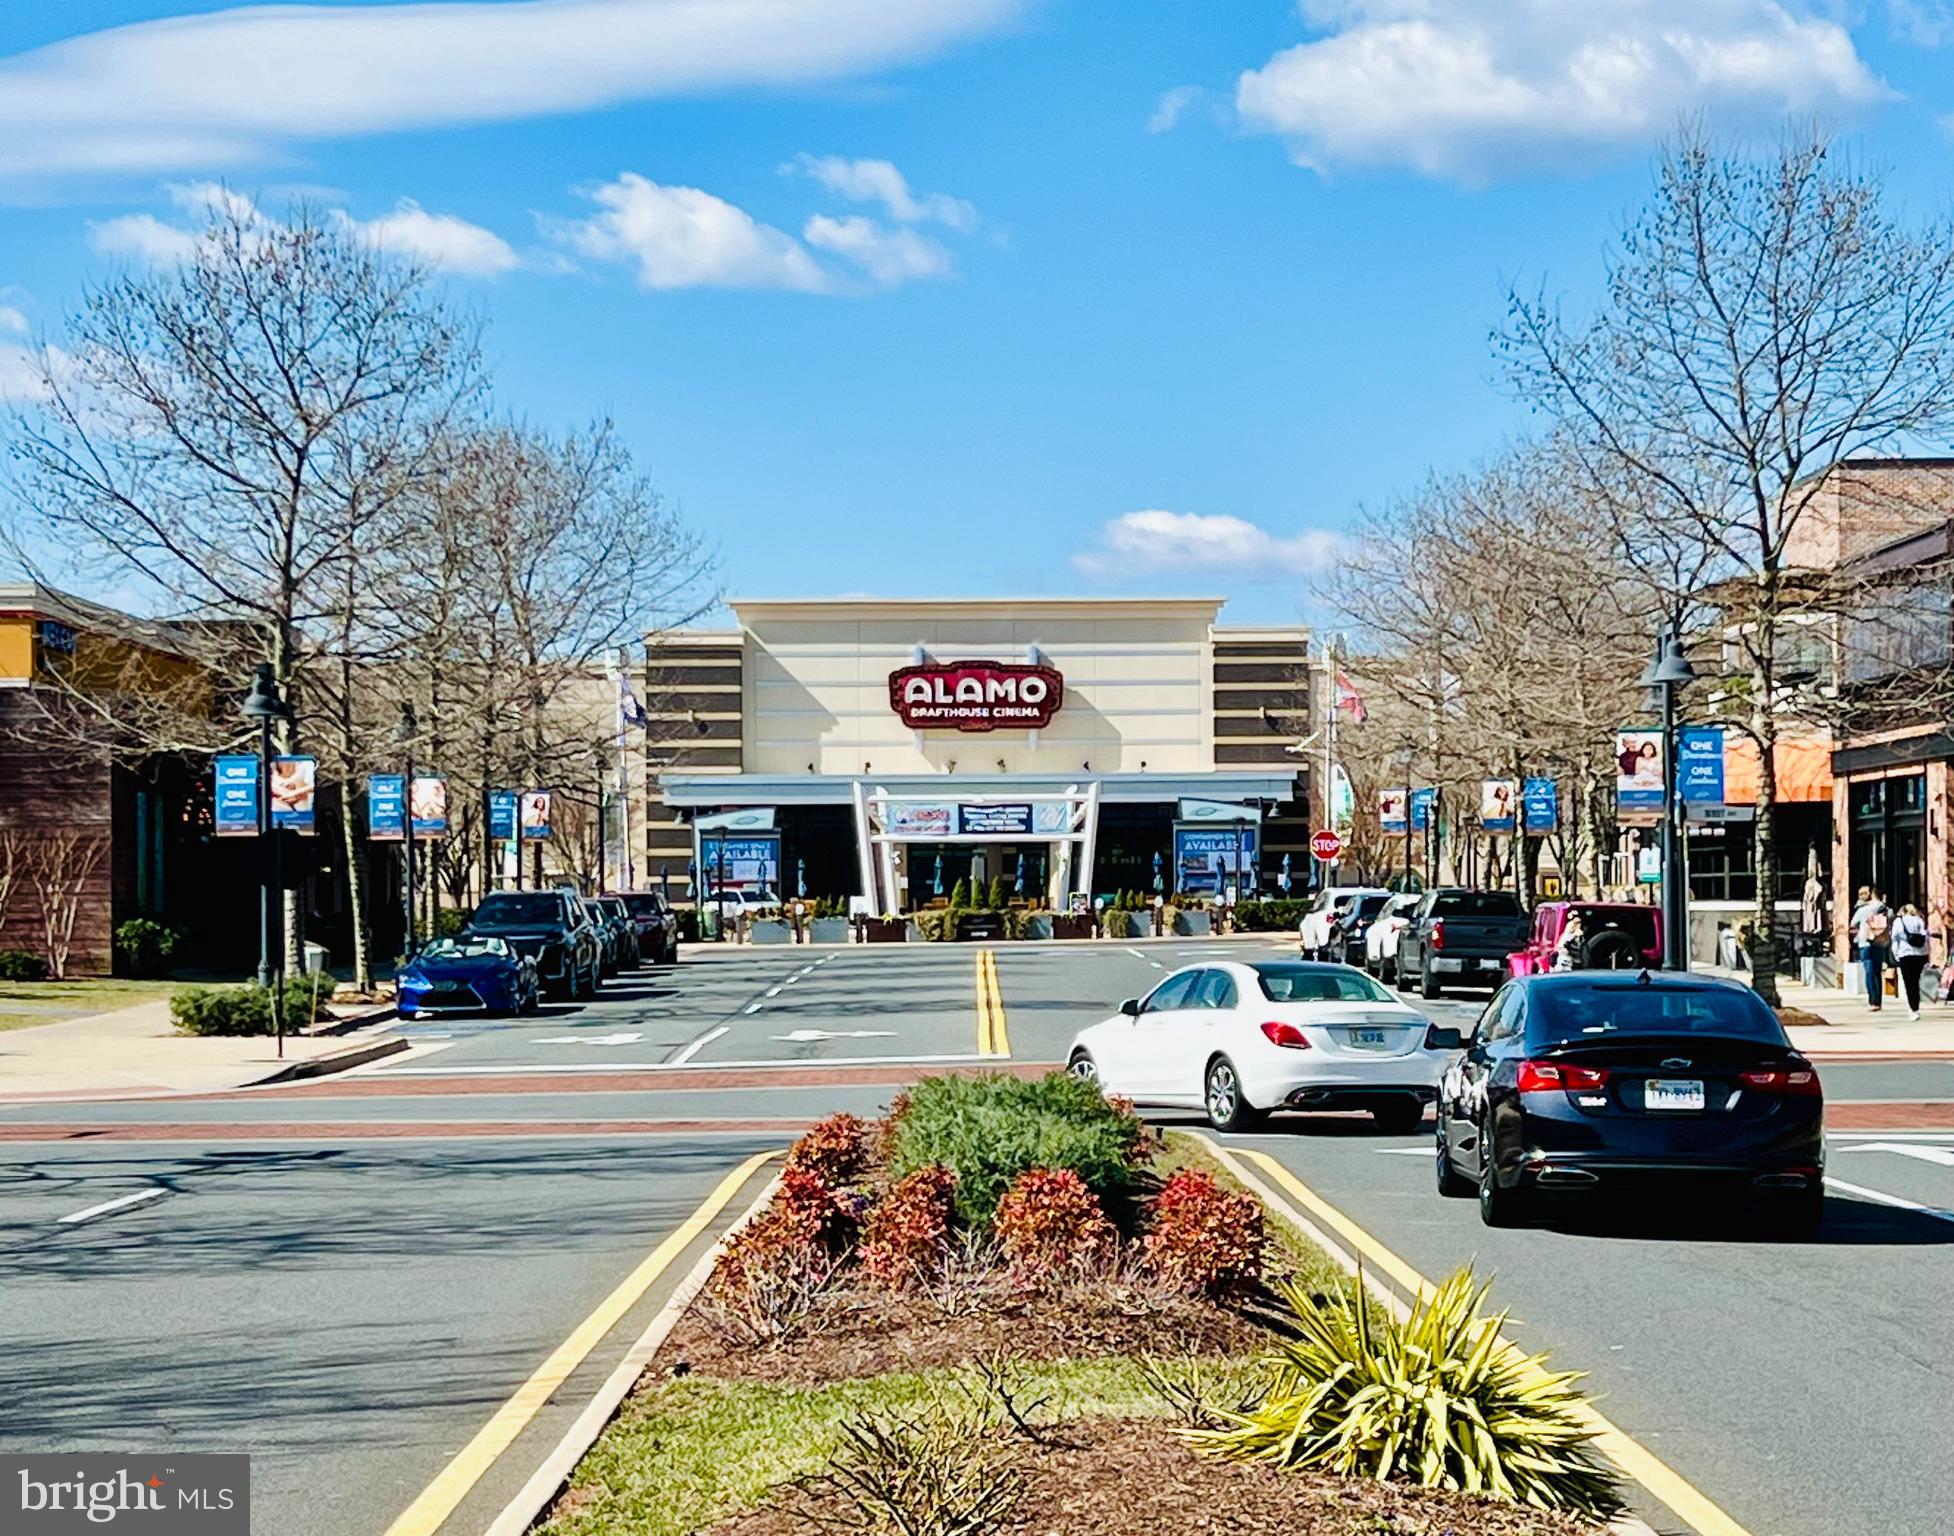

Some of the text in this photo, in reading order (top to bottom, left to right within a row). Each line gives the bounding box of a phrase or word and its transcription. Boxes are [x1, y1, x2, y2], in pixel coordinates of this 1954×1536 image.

[904, 677, 1047, 703] ALAMO
[911, 707, 1040, 717] DRAFTHOUSE CINEMA
[1690, 741, 1713, 750] ONE
[1691, 766, 1713, 775] ONE
[1313, 839, 1340, 852] STOP
[709, 850, 771, 860] AAILABLE
